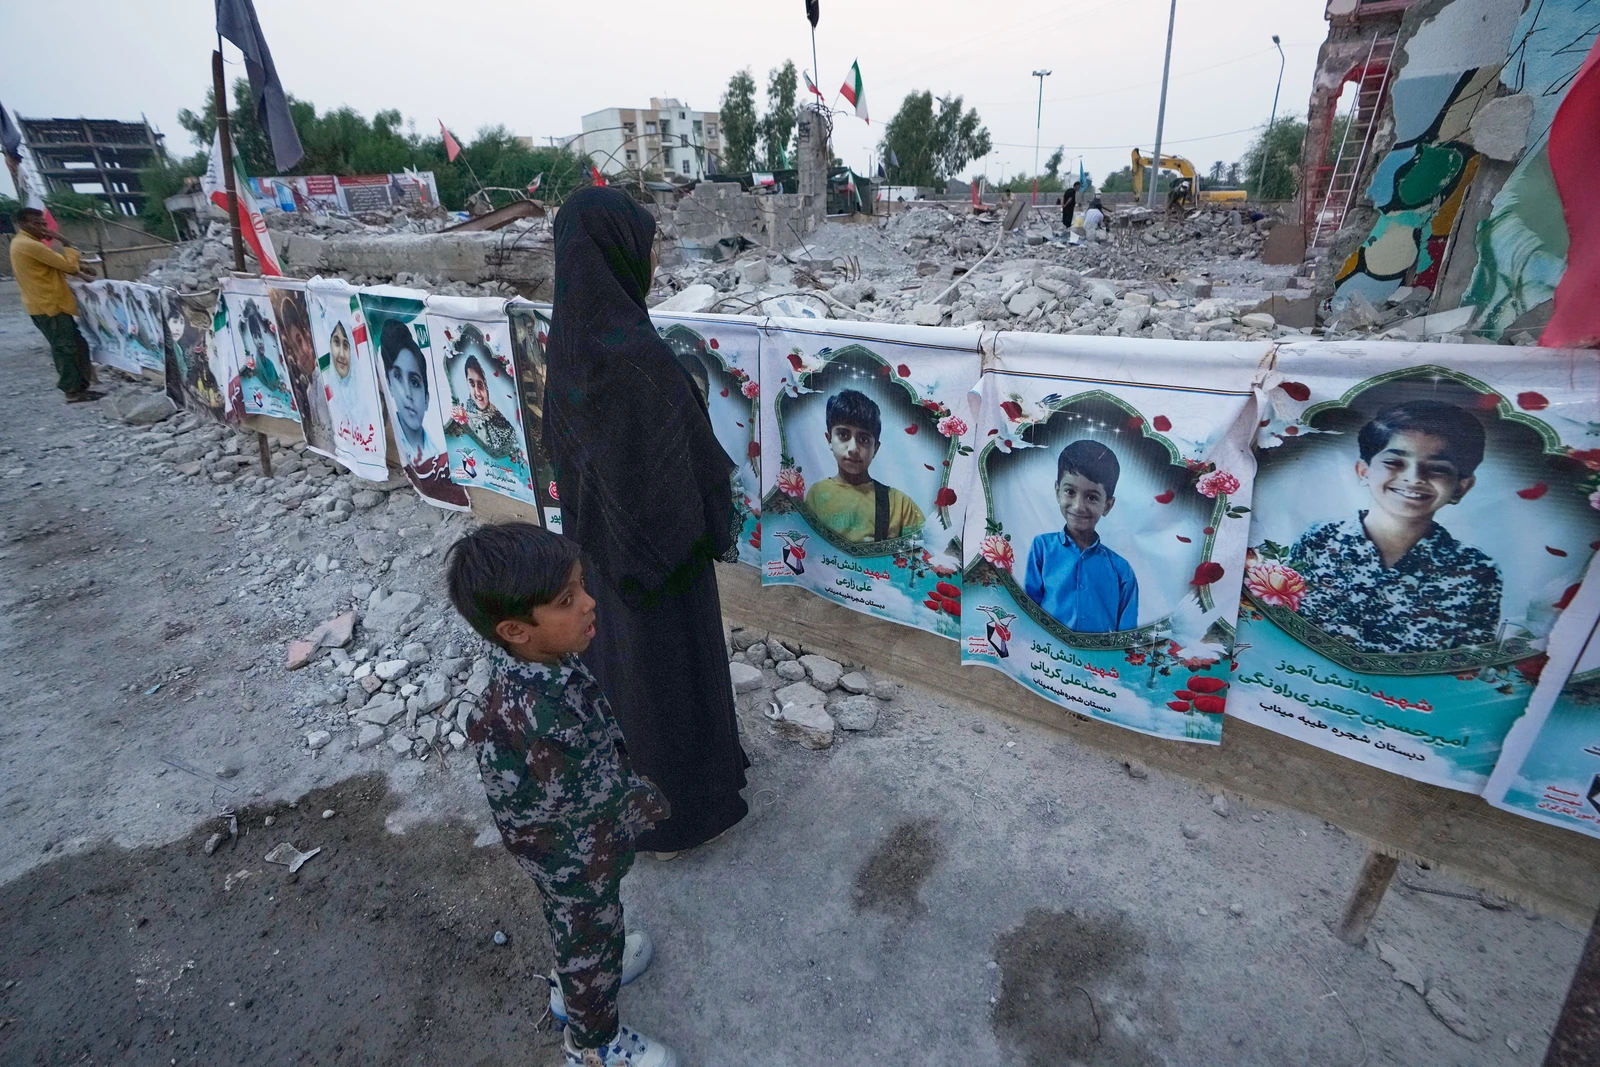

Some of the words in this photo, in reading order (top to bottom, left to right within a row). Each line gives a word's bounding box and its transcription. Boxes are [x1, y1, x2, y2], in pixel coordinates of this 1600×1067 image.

[863, 567, 891, 580] شهید
[835, 578, 856, 590] زارعی
[855, 581, 873, 592] علی
[824, 587, 840, 596] میناب
[851, 596, 866, 604] شجره
[865, 600, 886, 610] دبستان
[1084, 661, 1120, 680] شهید
[1032, 677, 1050, 690] میناب
[1050, 686, 1065, 698] طیبه
[1064, 692, 1084, 704] شجره
[1083, 699, 1112, 713] دبستان
[1294, 692, 1360, 718] جعفری
[1371, 690, 1434, 713] شهید
[1259, 701, 1294, 719] میناب
[1297, 713, 1329, 730] طیبه
[1331, 726, 1371, 744] شجره
[1374, 740, 1426, 762] دبستان
